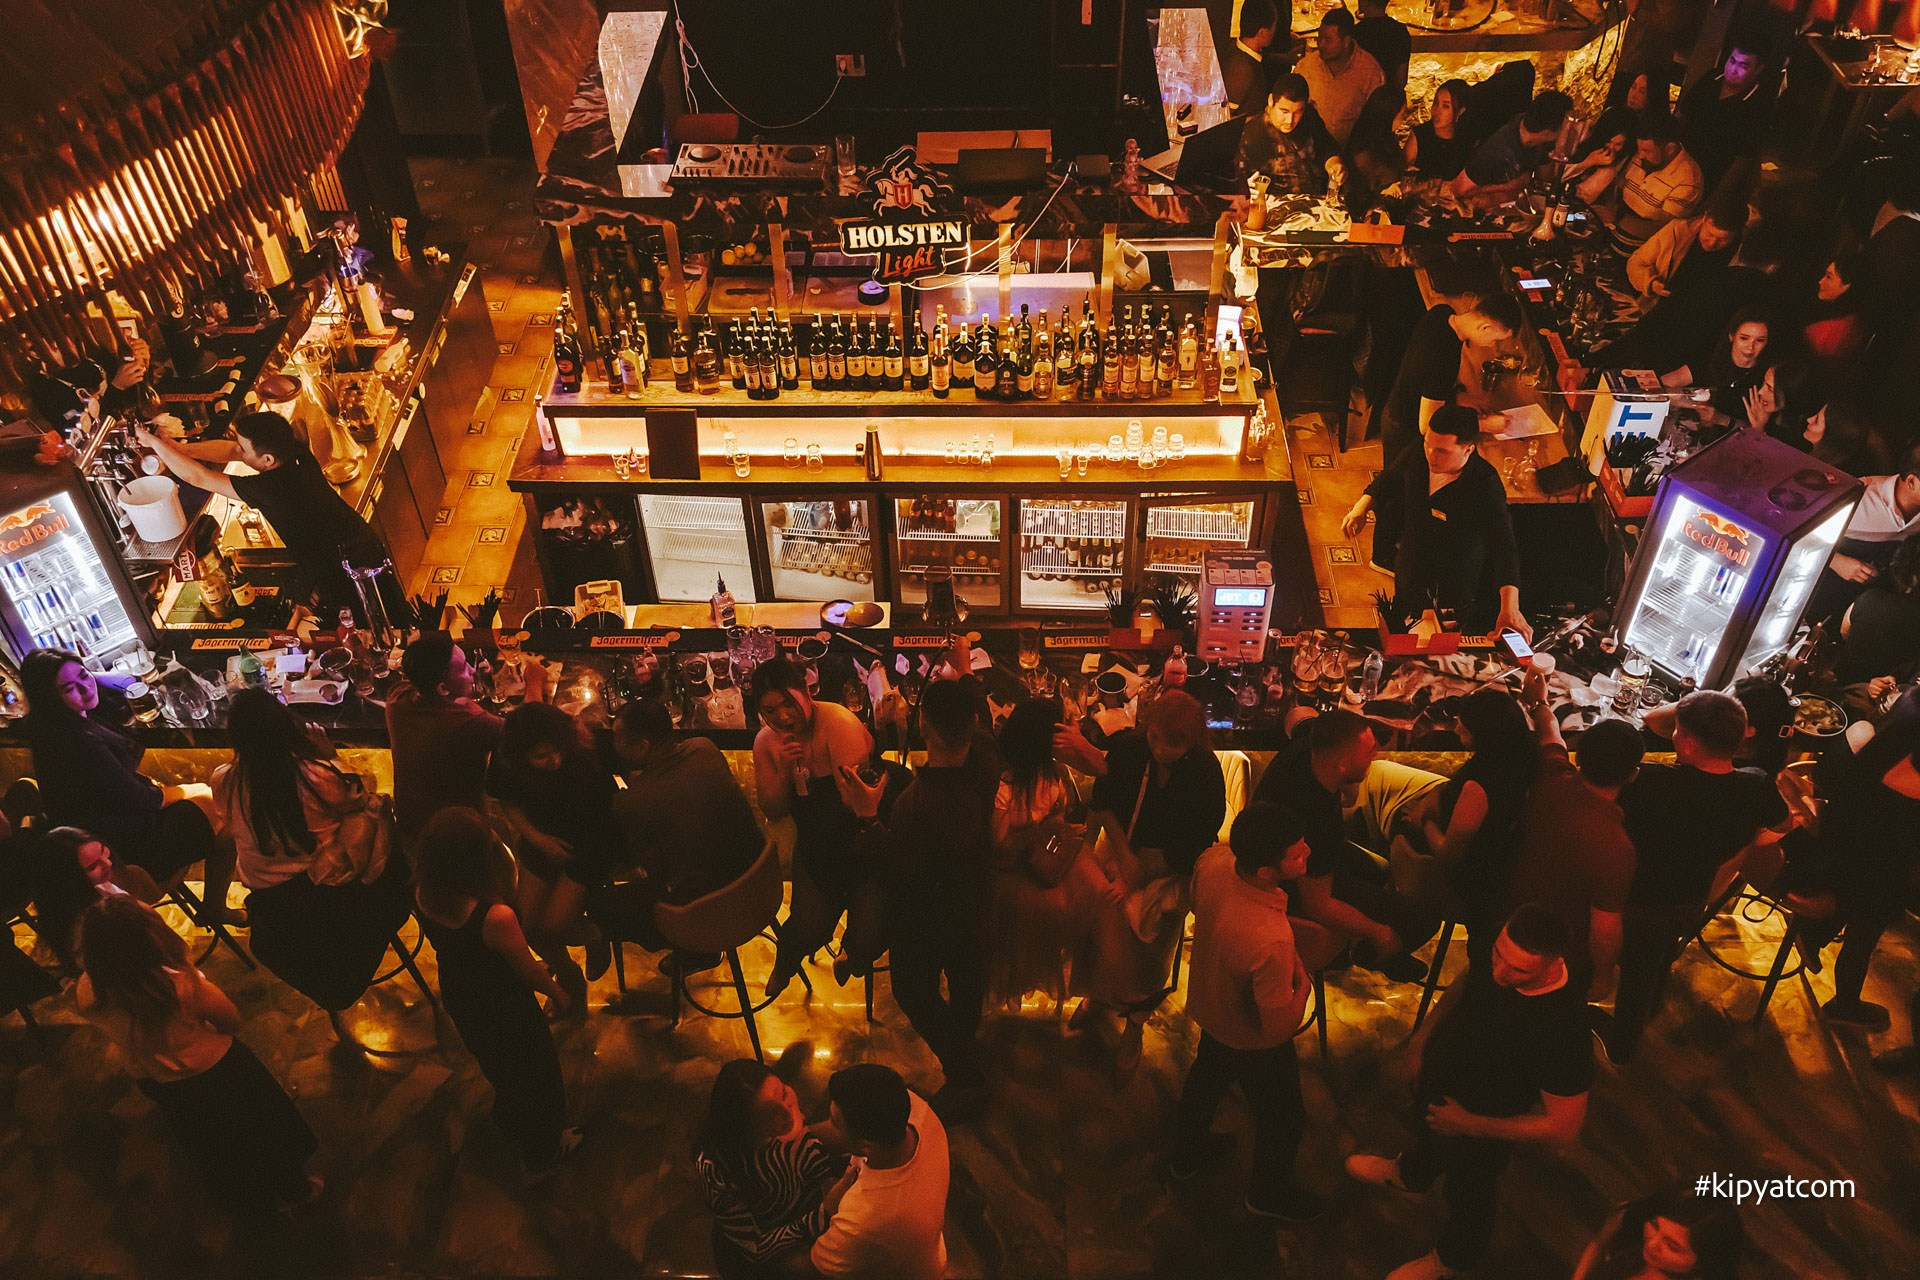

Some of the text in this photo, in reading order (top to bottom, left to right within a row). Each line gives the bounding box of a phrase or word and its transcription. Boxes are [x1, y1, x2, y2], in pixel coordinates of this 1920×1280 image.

[847, 221, 962, 249] HOLSTEN
[882, 245, 937, 278] Light
[0, 513, 70, 557] Red Bull
[1681, 520, 1751, 567] Red Bull
